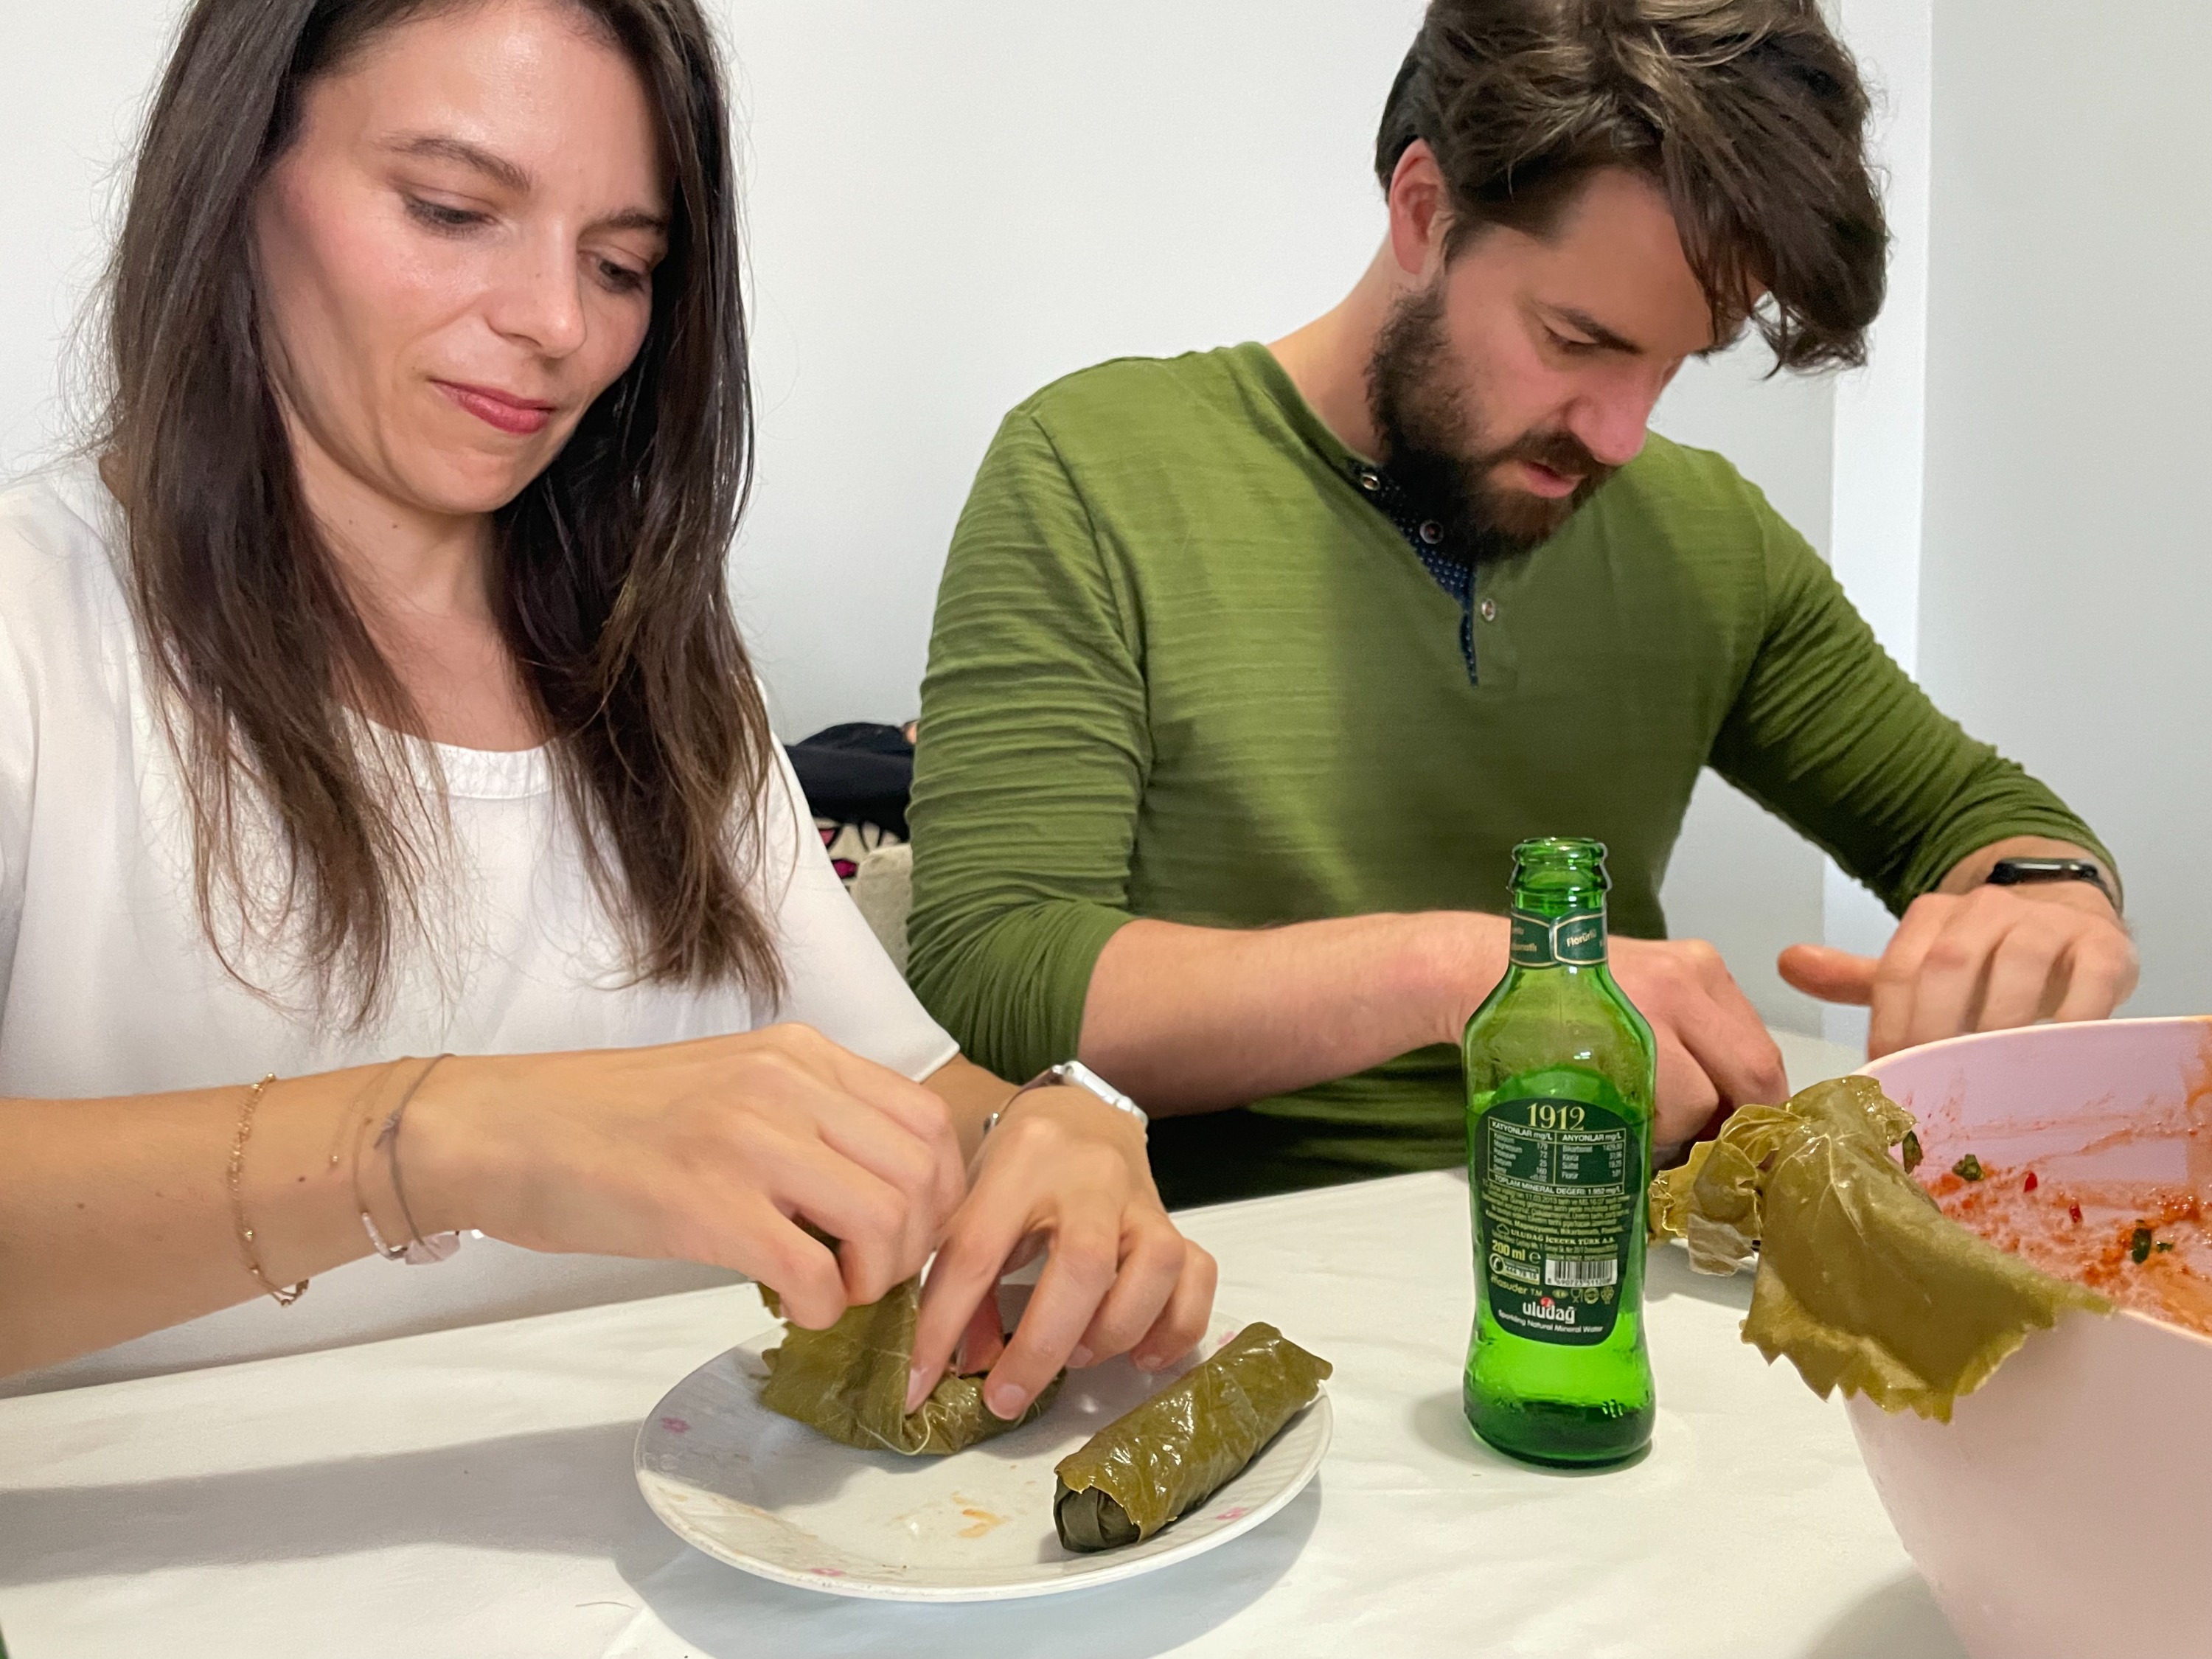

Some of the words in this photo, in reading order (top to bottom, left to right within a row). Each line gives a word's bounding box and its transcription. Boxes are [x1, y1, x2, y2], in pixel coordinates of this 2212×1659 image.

[1527, 1102, 1585, 1132] 1912
[1492, 1121, 1532, 1137] KATYONLAR
[1562, 1134, 1604, 1142] ANYONLAR
[1494, 1174, 1520, 1187] TOPLAM
[1492, 1239, 1510, 1256] 200
[1512, 1249, 1526, 1261] ml
[1527, 1319, 1554, 1331] Natural
